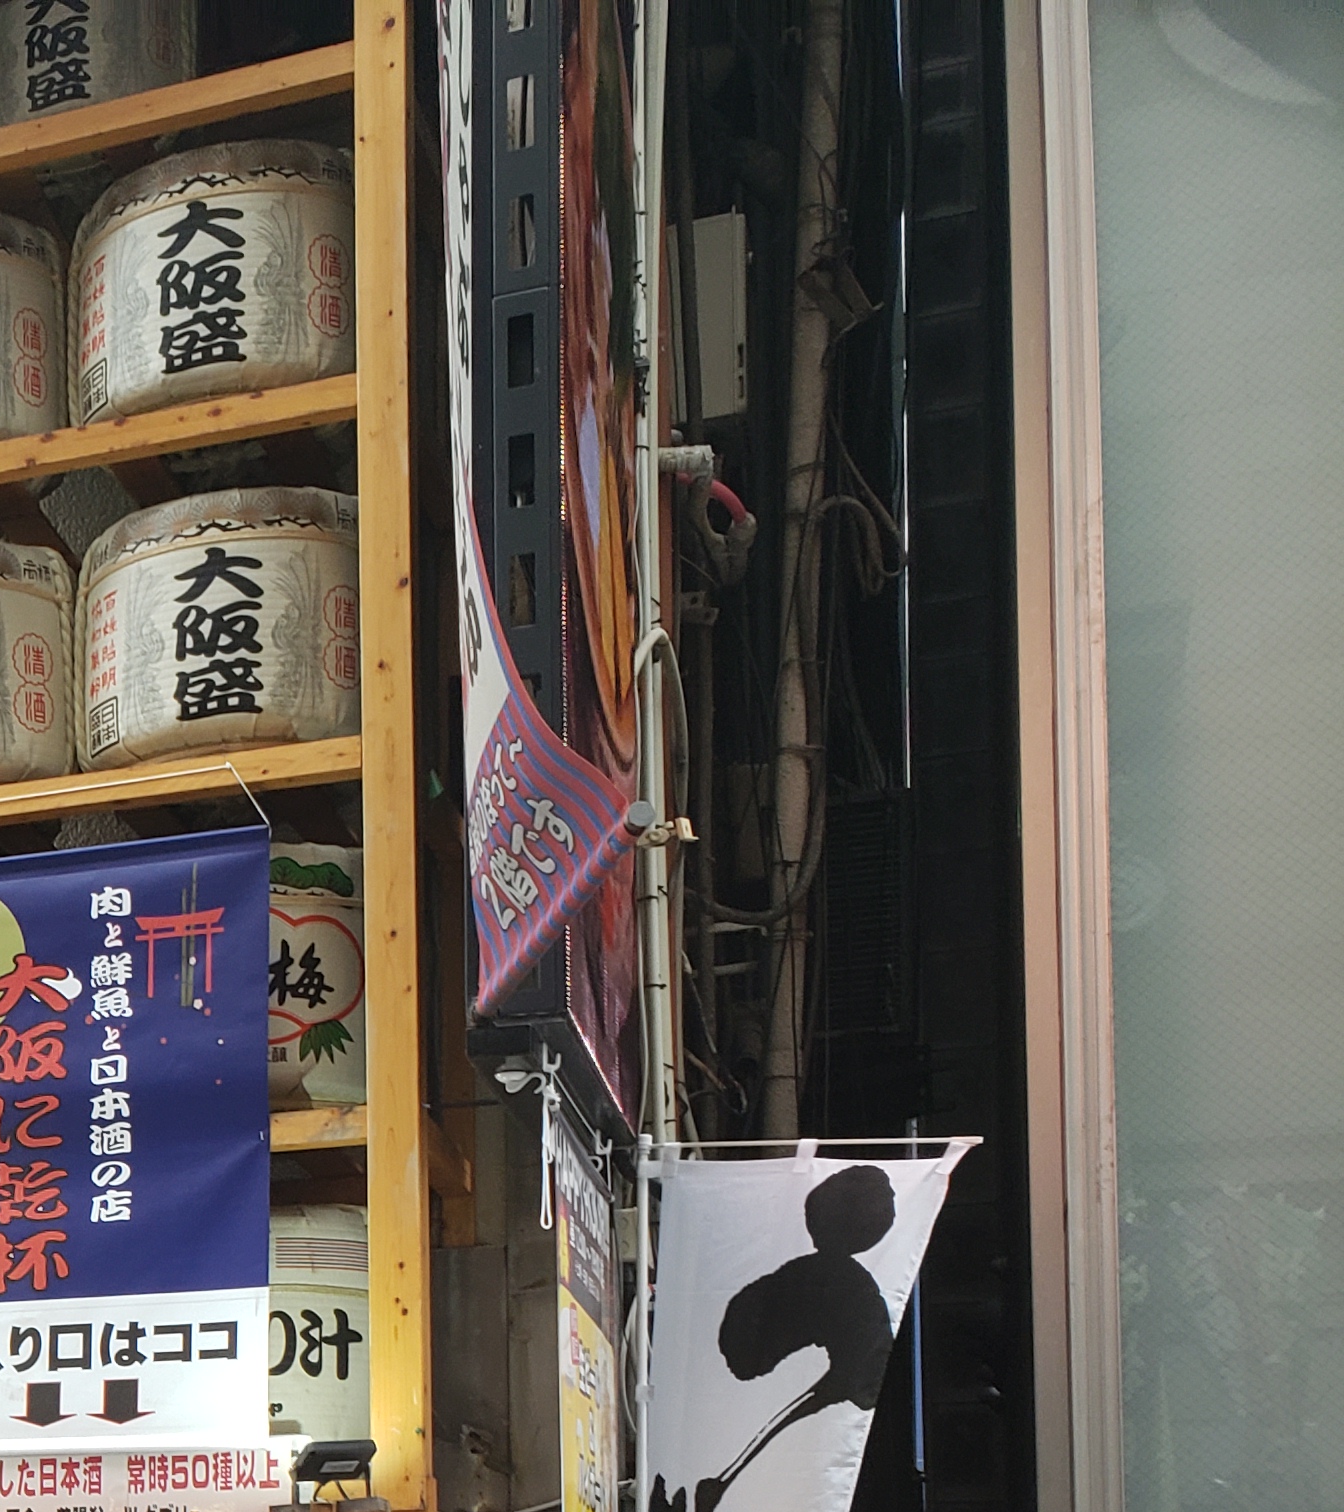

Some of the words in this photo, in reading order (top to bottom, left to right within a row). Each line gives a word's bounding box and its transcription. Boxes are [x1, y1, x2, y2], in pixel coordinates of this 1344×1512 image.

[156, 200, 247, 374] 大阪盛
[173, 547, 263, 721] 大阪盛
[89, 887, 133, 1224] 肉と鮮魚と日本酒の店
[127, 1449, 281, 1495] 常時50種以上
